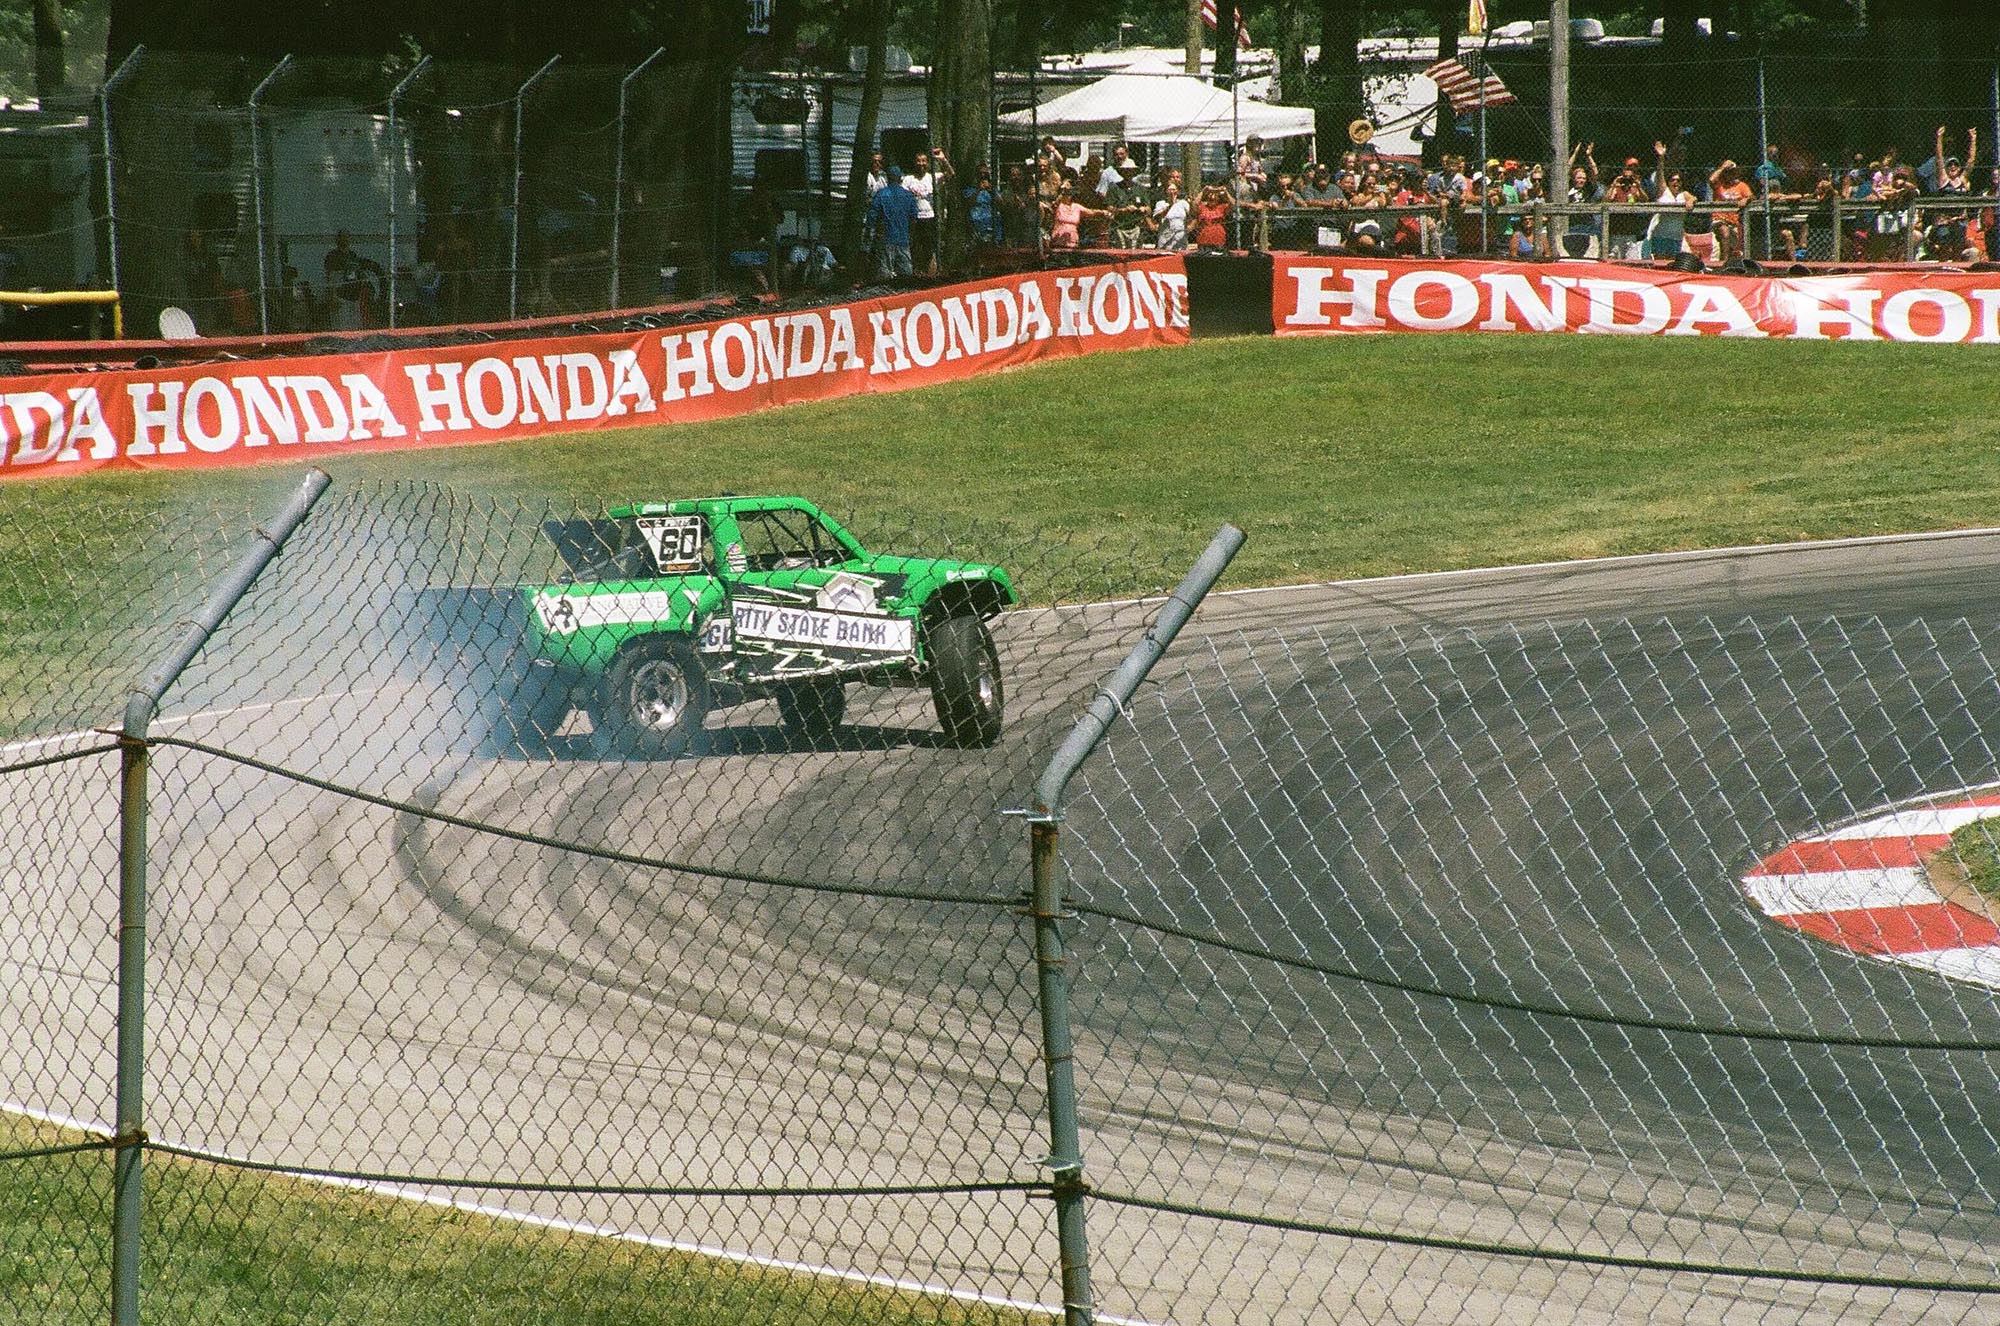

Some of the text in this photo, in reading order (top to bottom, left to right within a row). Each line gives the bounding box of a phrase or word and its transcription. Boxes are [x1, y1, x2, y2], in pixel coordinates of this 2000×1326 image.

[869, 280, 1052, 374] HONDA
[1285, 267, 1768, 338] HONDA
[404, 350, 656, 432] HONDA
[661, 308, 864, 402] HONDA
[0, 388, 117, 466] DA
[126, 374, 407, 456] HONDA
[659, 528, 698, 561] 60
[778, 612, 830, 638] STATE
[837, 619, 886, 645] BANK
